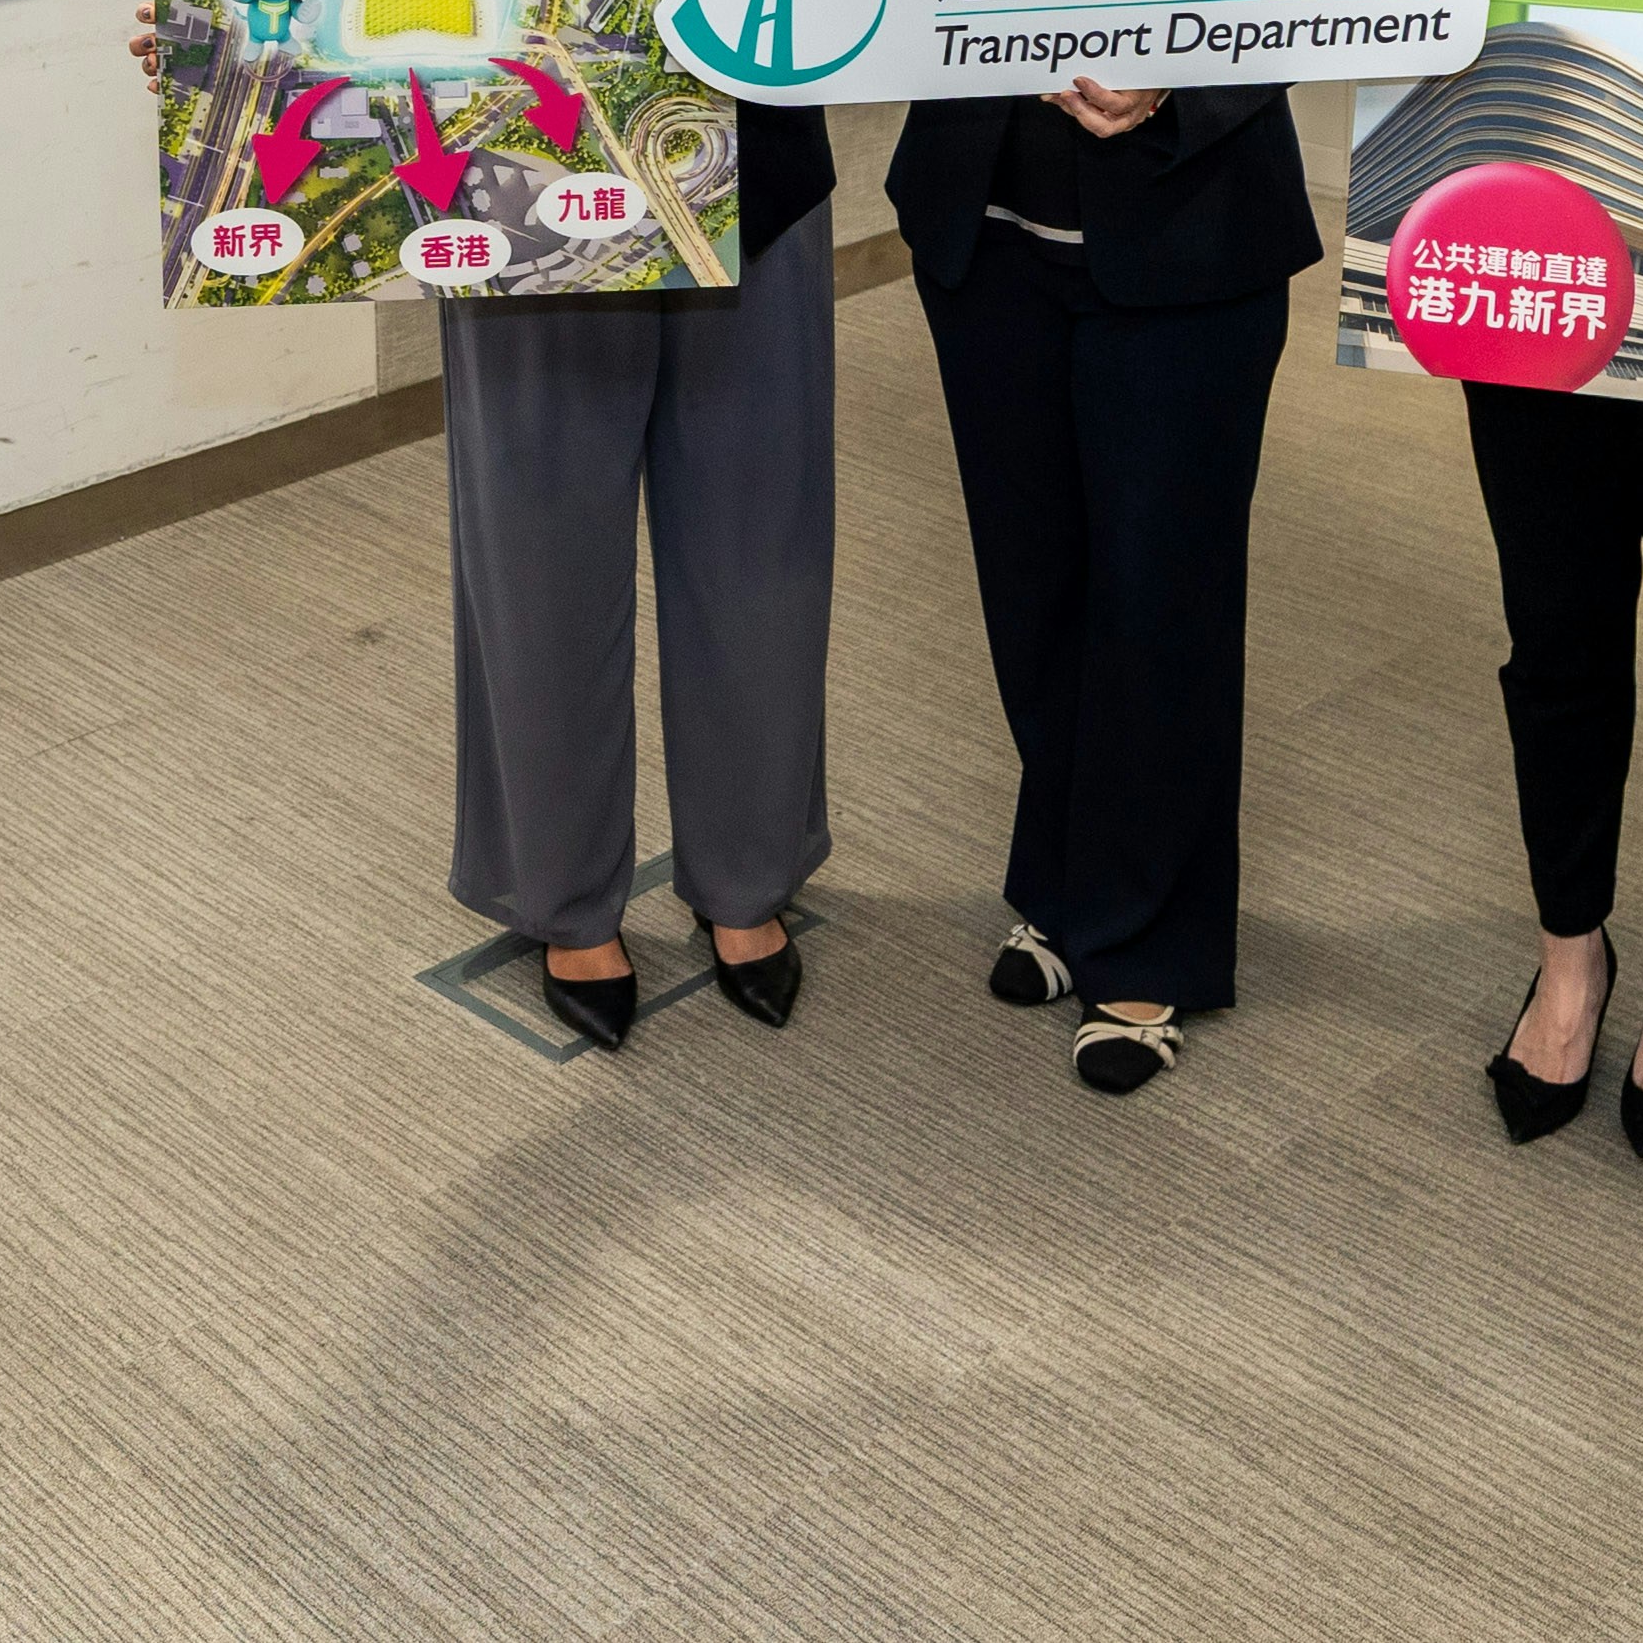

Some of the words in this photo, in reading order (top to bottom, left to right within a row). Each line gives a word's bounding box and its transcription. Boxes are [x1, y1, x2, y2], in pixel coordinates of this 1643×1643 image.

[934, 14, 1153, 72] Transport
[1165, 6, 1451, 65] Department
[557, 187, 626, 223] 九龍
[212, 224, 284, 260] 新界
[420, 233, 491, 270] 香港
[1412, 238, 1608, 289] 公共運輸直達
[1407, 275, 1607, 340] 港九新界
